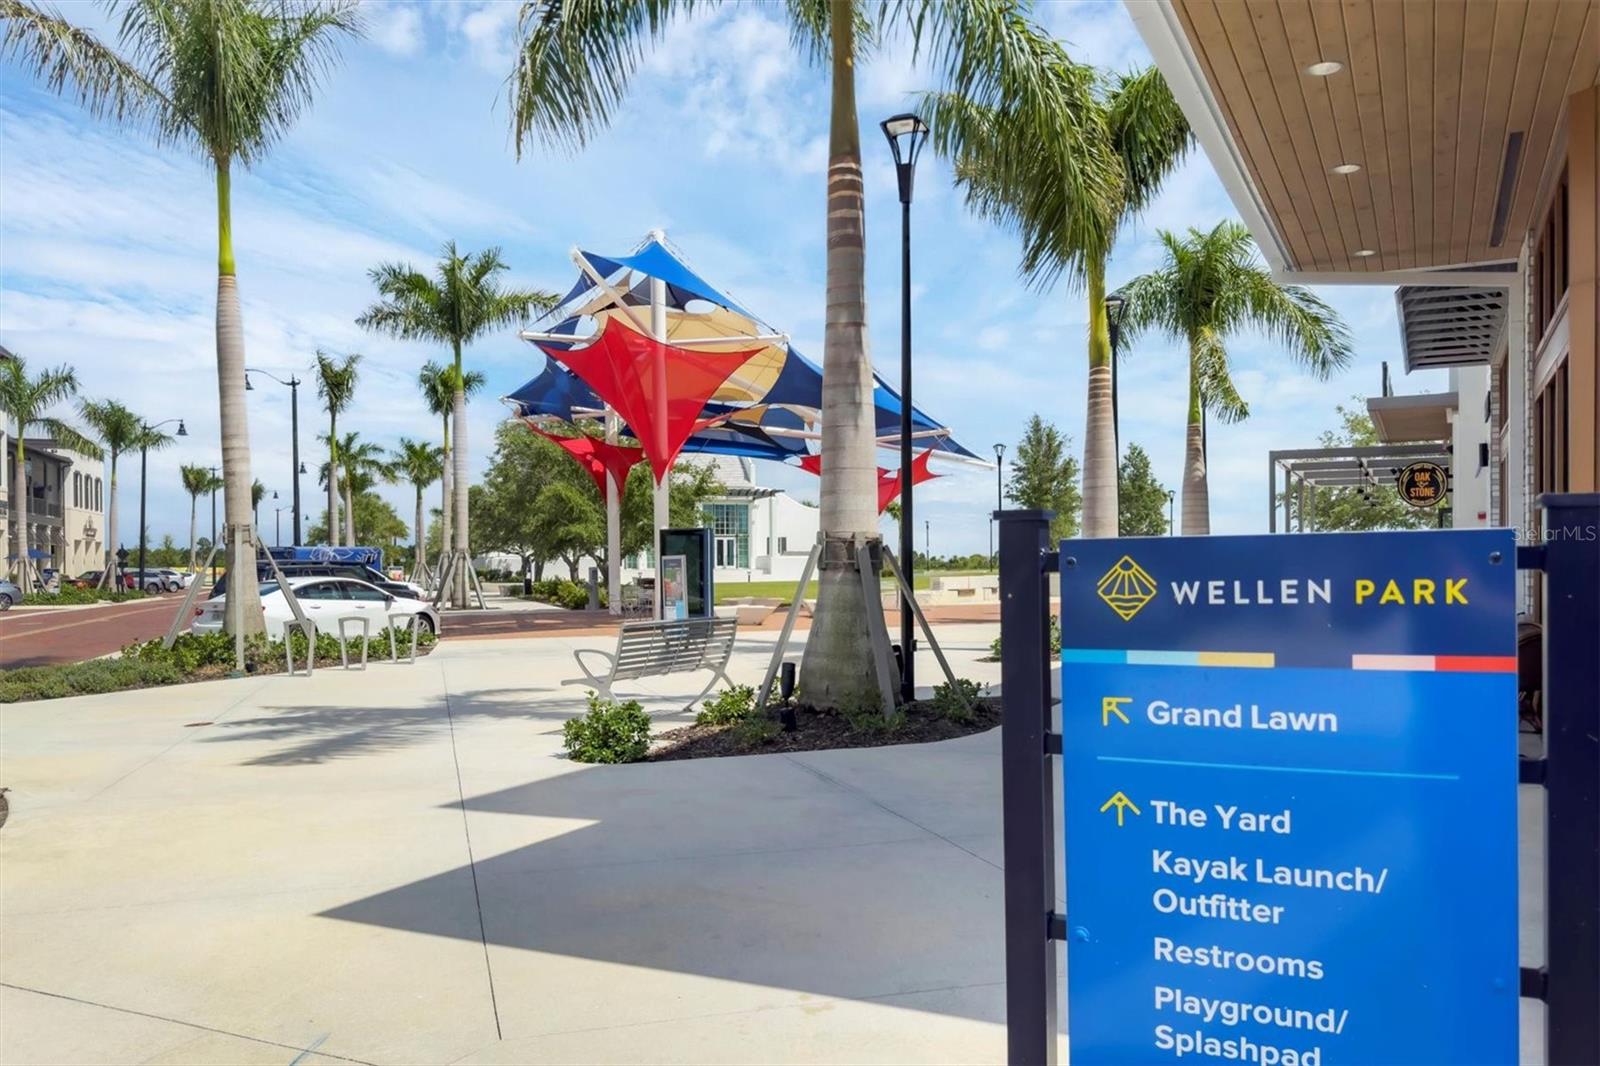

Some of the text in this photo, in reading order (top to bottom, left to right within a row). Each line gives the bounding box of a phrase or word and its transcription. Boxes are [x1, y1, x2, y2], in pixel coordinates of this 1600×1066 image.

[1410, 487, 1436, 497] STONE
[1414, 471, 1431, 481] OAK
[1170, 577, 1470, 605] WELLEN PARK
[1146, 700, 1338, 733] Grand Lawn
[1150, 800, 1292, 835] The Yard
[1152, 849, 1388, 894] Kayak Launch/
[1152, 888, 1285, 924] Outfitter
[1154, 936, 1324, 980] Restrooms
[1154, 985, 1349, 1034] Playground/
[1154, 1024, 1321, 1066] Splashpad
